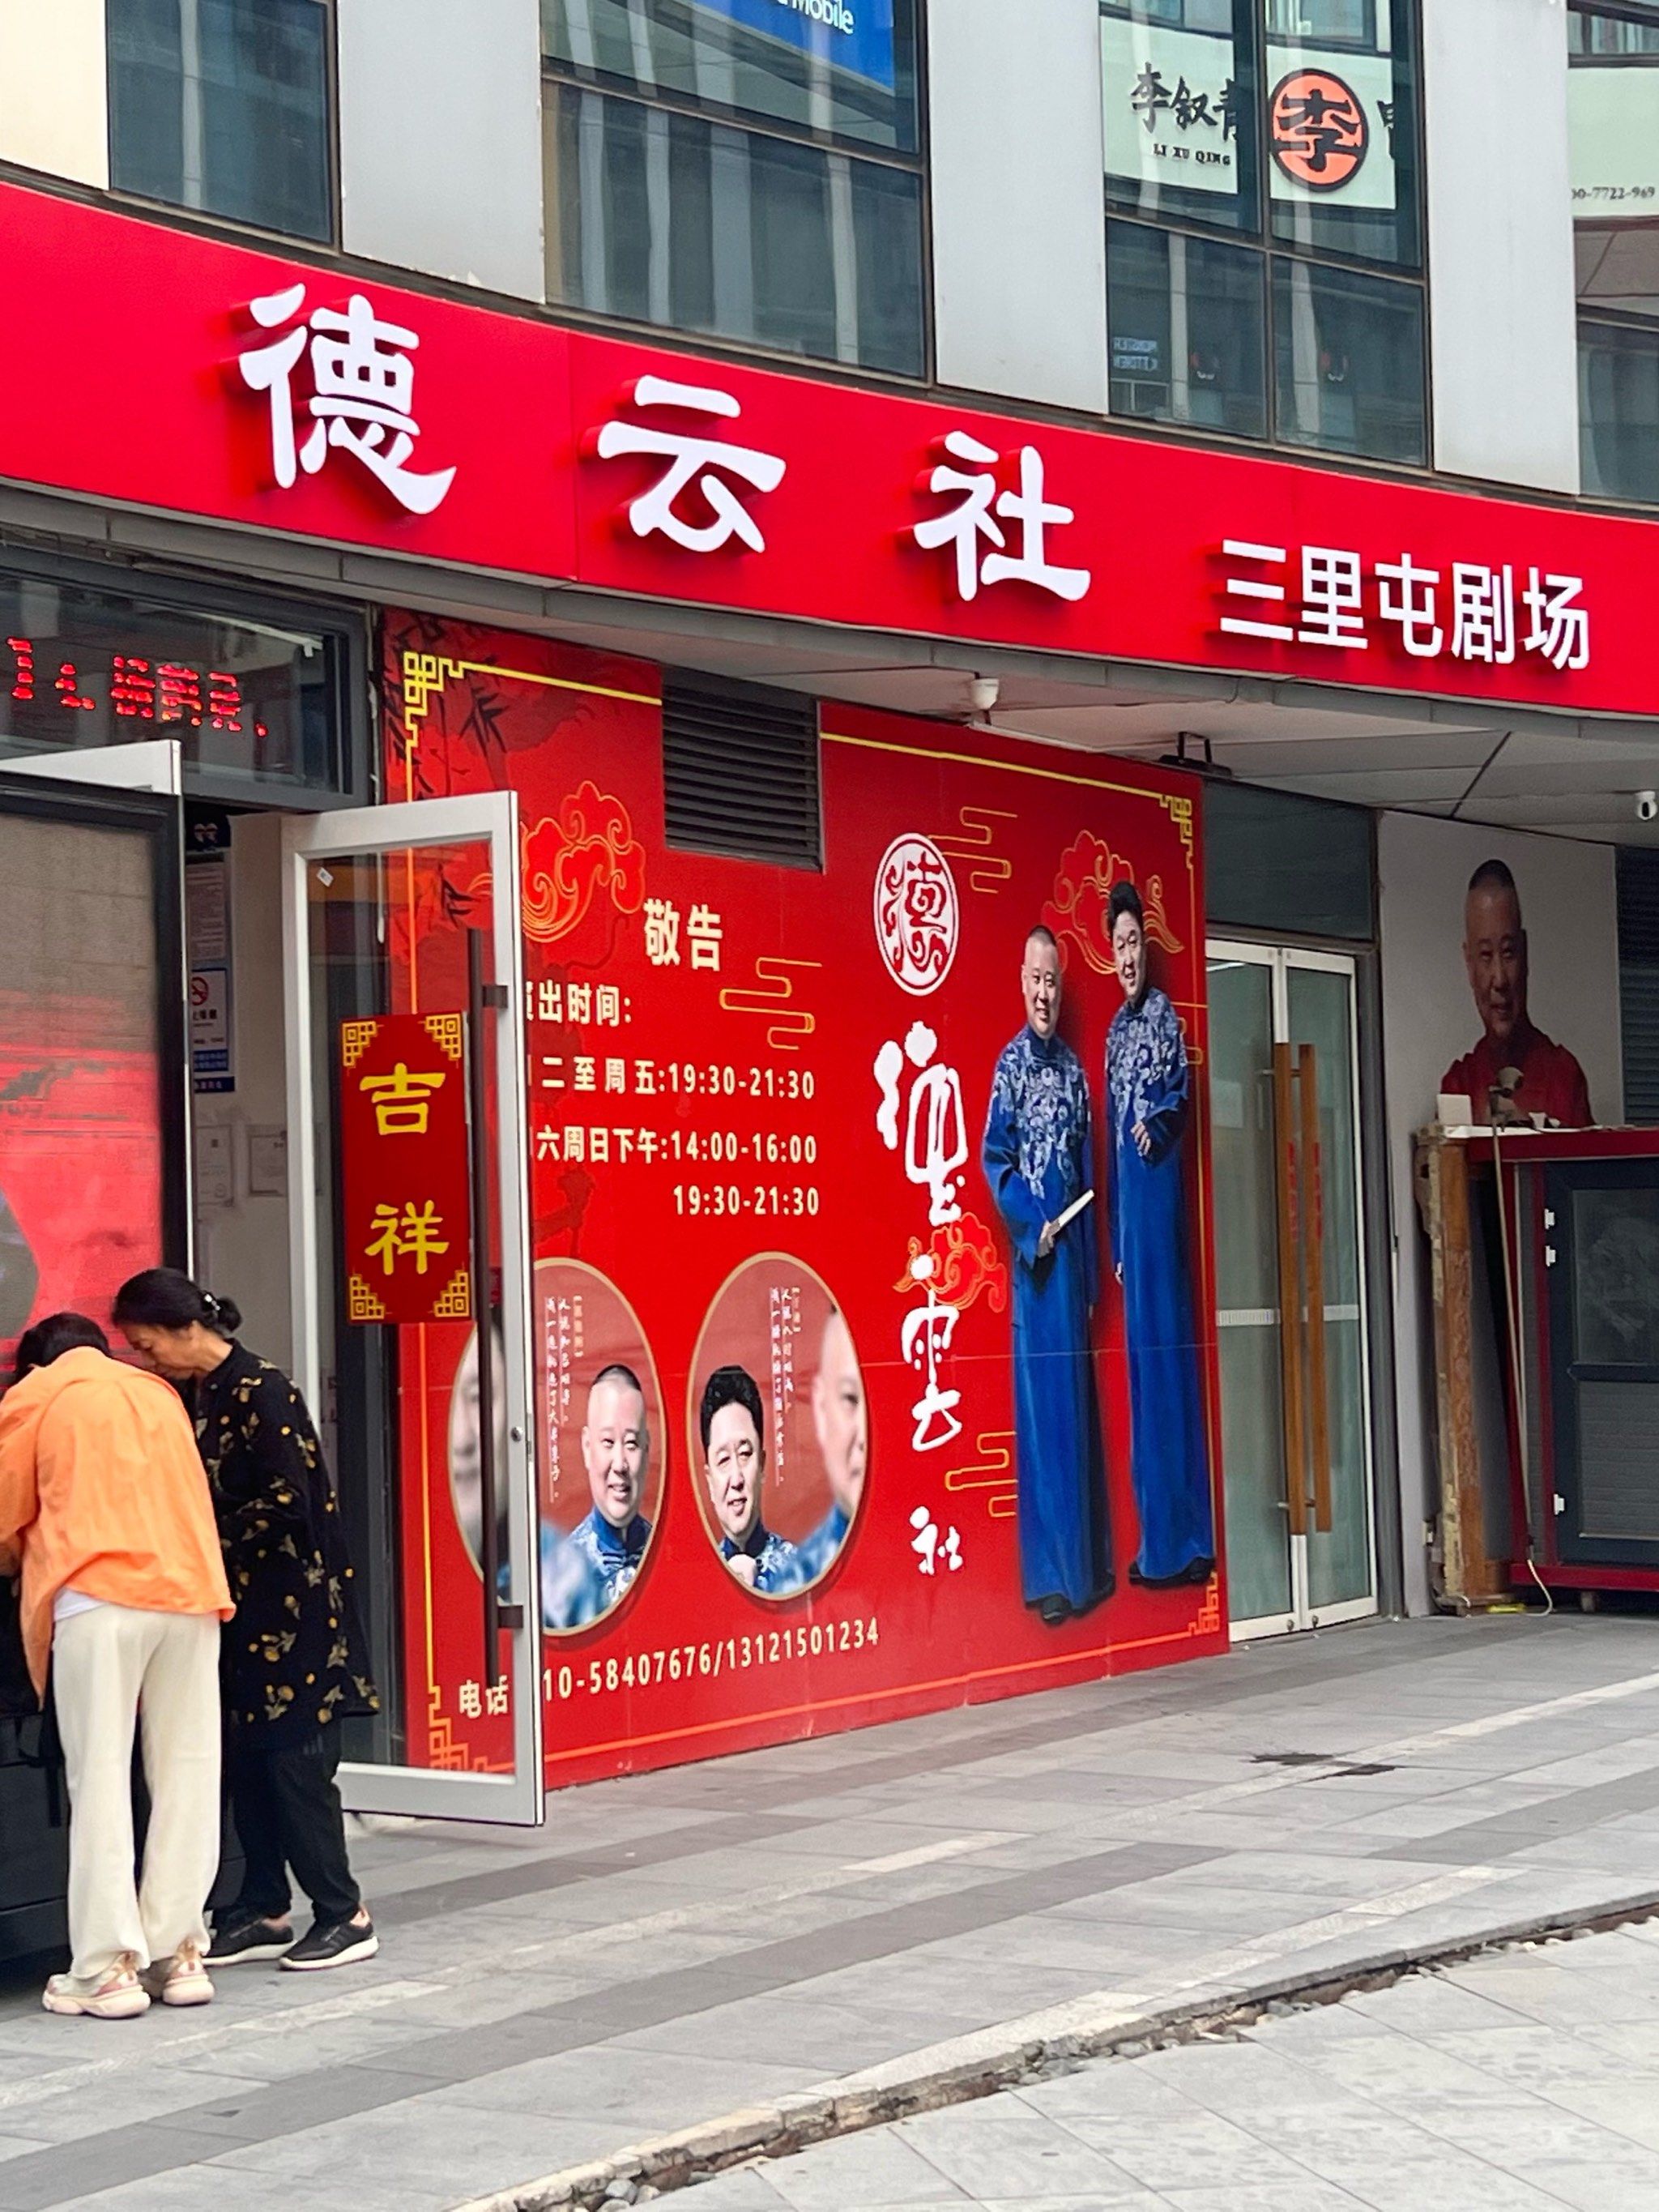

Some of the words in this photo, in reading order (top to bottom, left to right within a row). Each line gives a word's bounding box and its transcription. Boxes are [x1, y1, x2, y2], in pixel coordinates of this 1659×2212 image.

[1271, 87, 1364, 173] 李
[1154, 143, 1167, 157] LI
[1172, 147, 1190, 160] XU
[1195, 151, 1230, 166] QING
[238, 283, 1091, 601] 德云社
[1219, 539, 1591, 670] 三里屯剧场
[642, 898, 723, 972] 敬告
[528, 1055, 814, 1100] 二至周五:19:30-21:30
[531, 1124, 817, 1164] 六周日下午:14:00-16:00
[359, 1061, 450, 1275] 吉祥
[673, 1185, 820, 1216] 19:30-21:30
[459, 1674, 509, 1719] 电话
